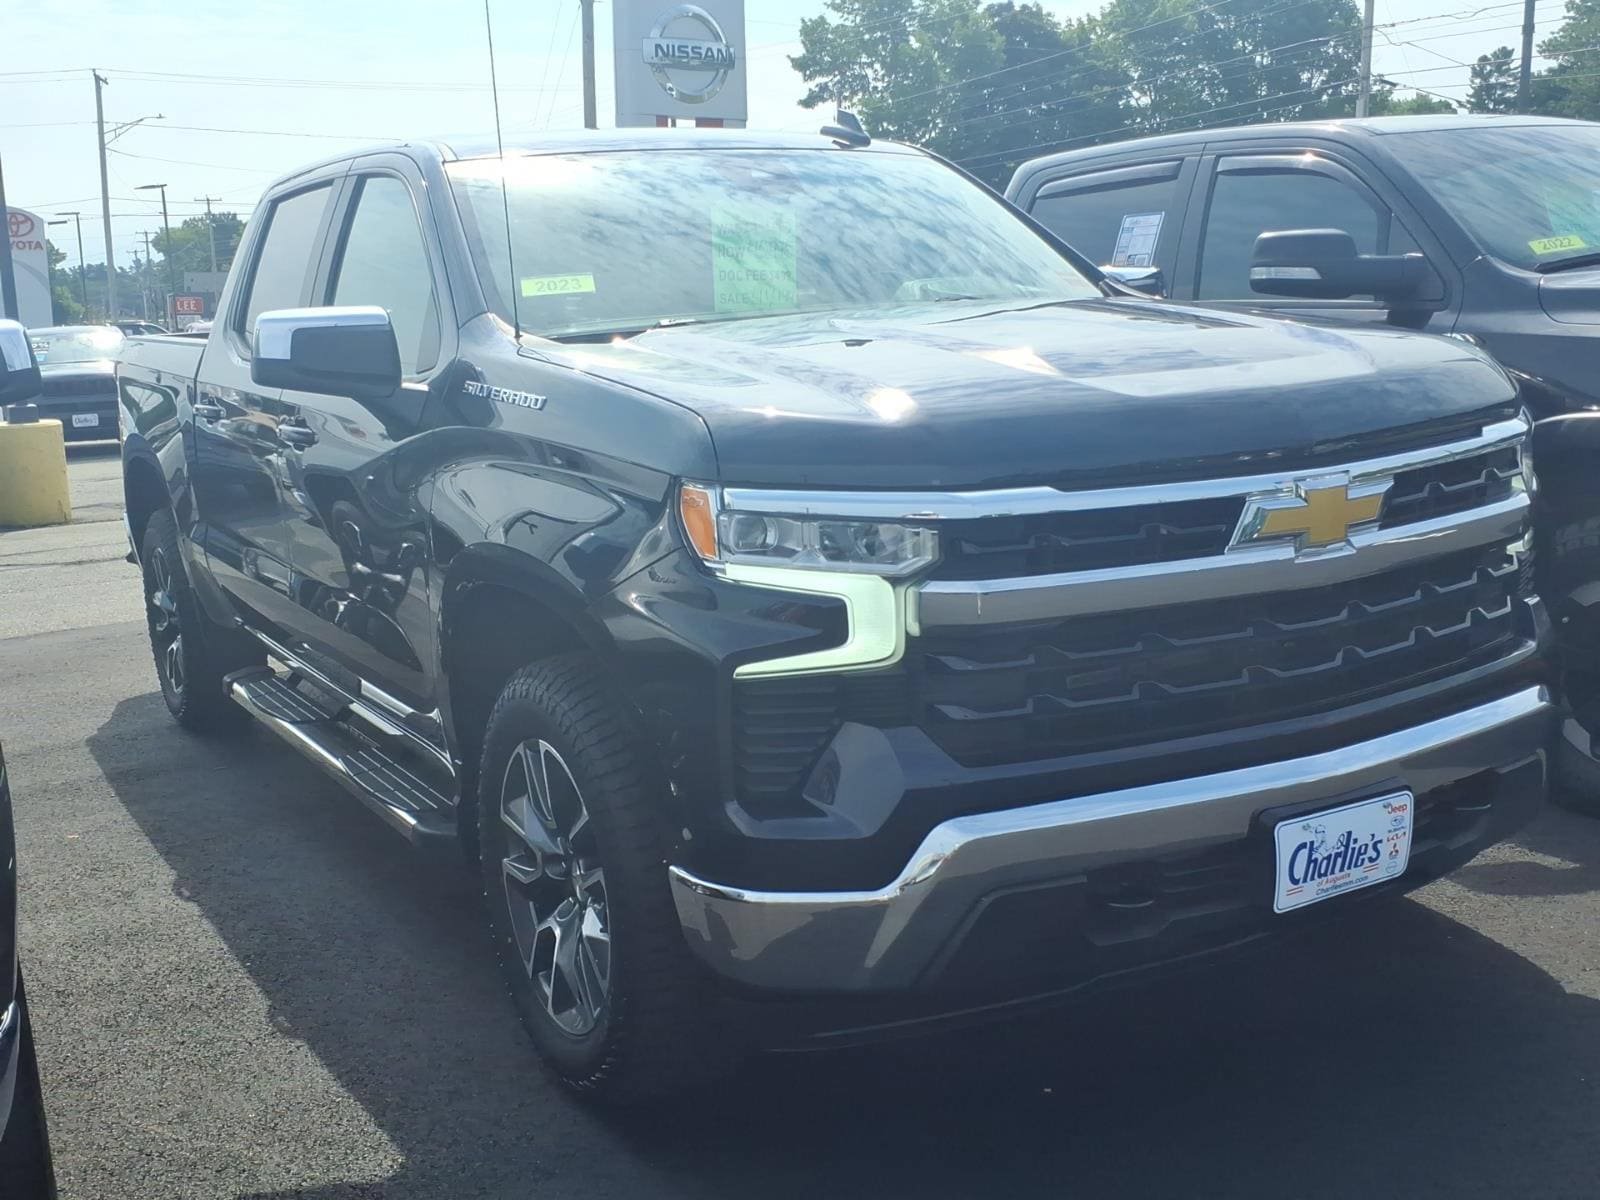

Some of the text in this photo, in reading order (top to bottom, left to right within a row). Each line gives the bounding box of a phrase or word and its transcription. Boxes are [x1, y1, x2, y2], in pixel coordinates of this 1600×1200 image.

[654, 43, 728, 62] NISSAN
[1537, 237, 1576, 250] 2022
[535, 278, 582, 293] 2023
[176, 300, 197, 311] LEE
[462, 380, 547, 410] SILVERADO
[1387, 803, 1408, 814] Jeep
[1287, 830, 1384, 886] Charlie's
